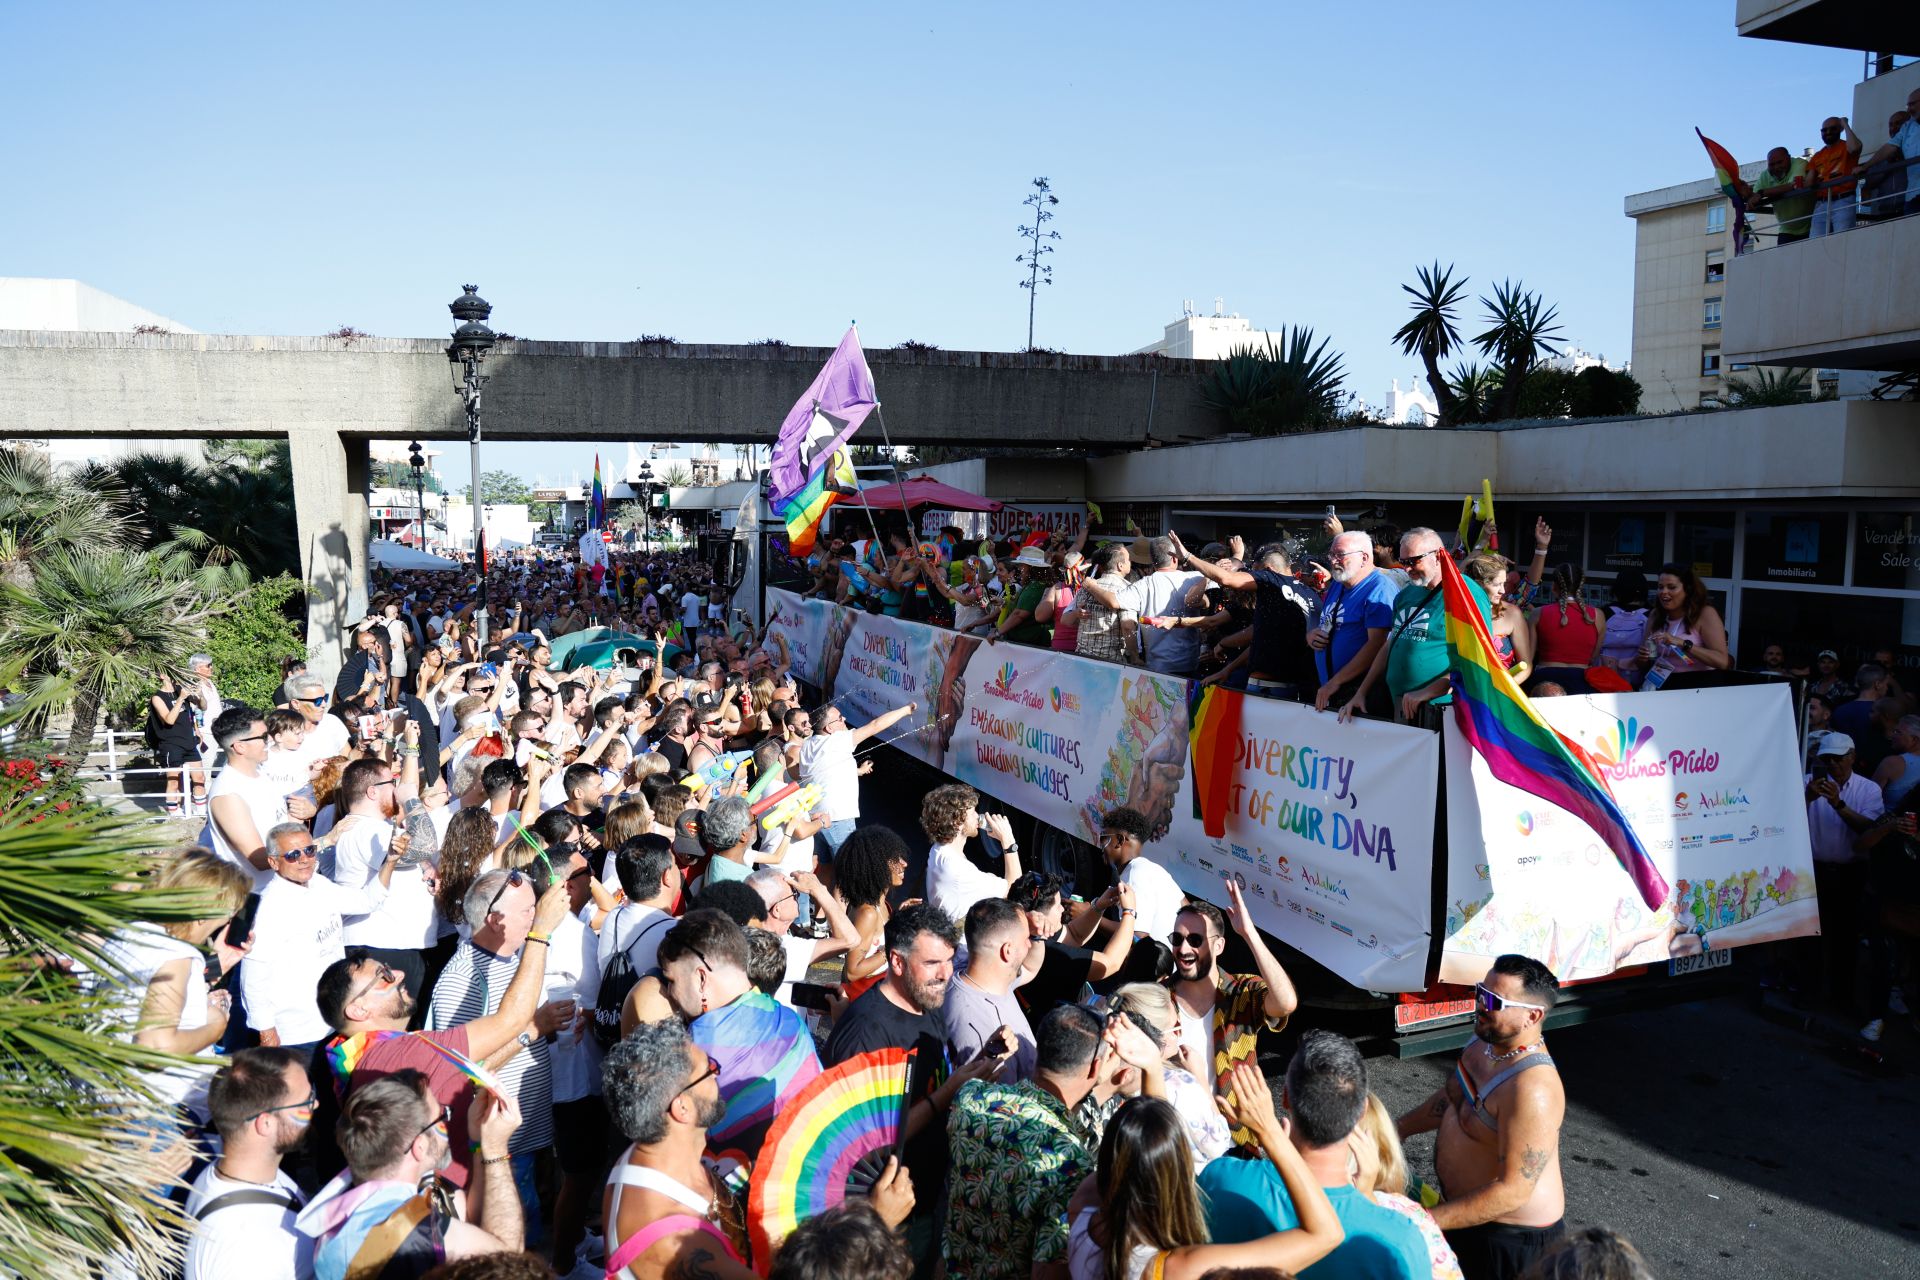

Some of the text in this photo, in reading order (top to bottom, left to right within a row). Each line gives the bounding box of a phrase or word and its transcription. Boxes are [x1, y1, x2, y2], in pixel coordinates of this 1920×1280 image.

[1037, 511, 1080, 537] BAZAR
[1864, 529, 1905, 545] Vende
[1880, 552, 1911, 567] Sale
[1767, 567, 1817, 579] Inmobiliaria
[1668, 747, 1720, 776] Pride
[1278, 798, 1326, 846] OUR
[1332, 811, 1397, 872] DNA
[1676, 949, 1728, 973] 8972 KVB
[1402, 1006, 1409, 1022] R
